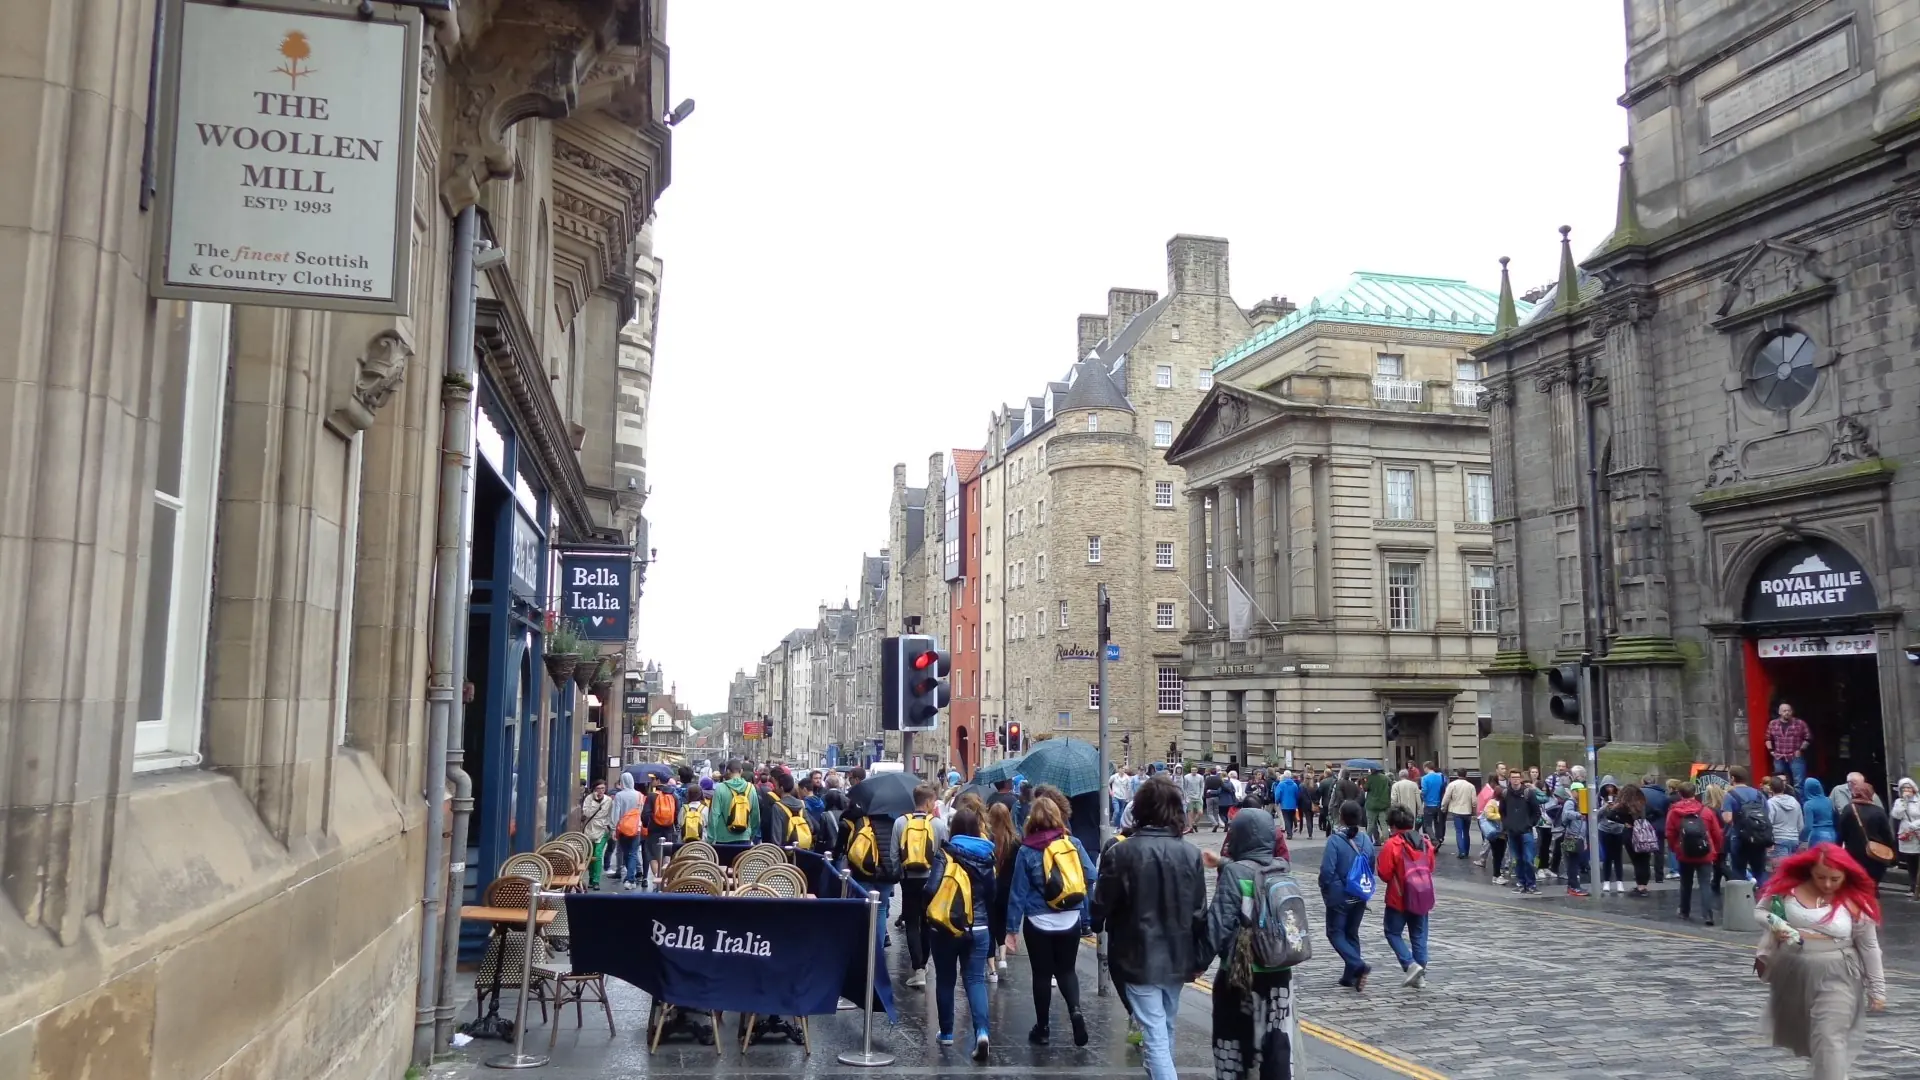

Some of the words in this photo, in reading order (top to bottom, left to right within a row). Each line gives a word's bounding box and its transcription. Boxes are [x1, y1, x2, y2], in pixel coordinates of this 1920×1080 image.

[253, 91, 330, 121] THE
[195, 122, 384, 162] WOOLLEN
[240, 163, 335, 195] MILL
[293, 201, 332, 214] 1993
[194, 243, 230, 259] The
[231, 245, 290, 263] finest
[295, 251, 369, 270] Scottish
[188, 263, 203, 277] &
[209, 265, 287, 286] Country
[293, 271, 373, 293] Clothing
[572, 567, 620, 586] Bella
[1760, 576, 1816, 594] ROYAL
[1820, 570, 1862, 588] MILE
[571, 591, 621, 610] Italia
[1776, 587, 1847, 607] MARKET
[650, 919, 705, 951] Bella
[712, 929, 772, 957] Italia
